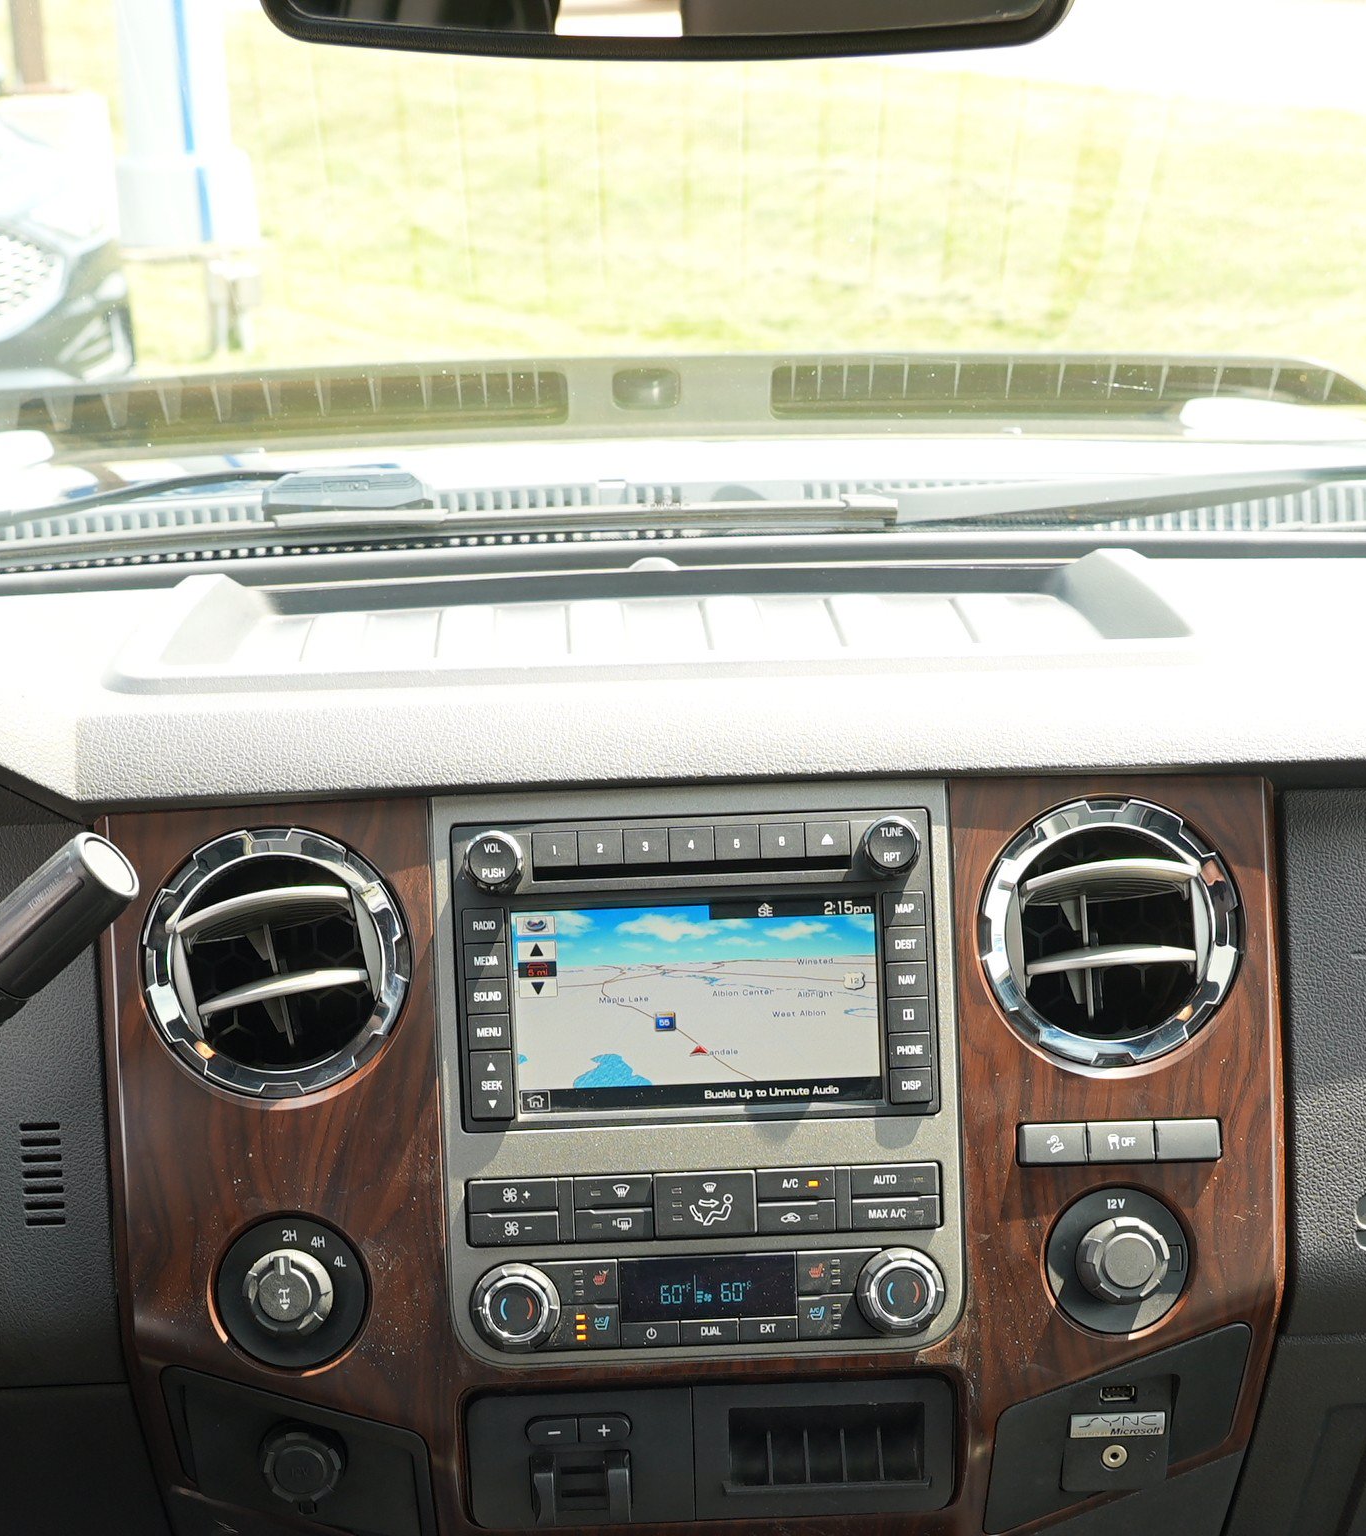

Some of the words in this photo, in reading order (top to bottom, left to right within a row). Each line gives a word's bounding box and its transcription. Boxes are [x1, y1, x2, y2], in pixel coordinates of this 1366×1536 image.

[880, 826, 903, 838] TUNE
[642, 842, 649, 852] 3
[688, 840, 694, 850] 4
[733, 838, 740, 848] 5
[778, 837, 785, 847] 6
[484, 843, 501, 853] VOL
[596, 843, 603, 853] 2
[884, 851, 901, 863] RPT
[481, 867, 505, 879] PUSH
[758, 906, 773, 917] SE
[824, 901, 872, 916] 2:15pm
[895, 904, 914, 914] MAP
[473, 921, 496, 931] RADIO
[895, 939, 916, 950] DEST
[474, 956, 498, 966] MEDIA
[797, 958, 834, 966] Winsted
[898, 975, 916, 985] NAV
[474, 991, 501, 1001] SOUND
[712, 989, 739, 997] Albion
[742, 988, 773, 996] Center
[797, 990, 833, 999] Albright
[599, 996, 624, 1004] Maple
[628, 995, 649, 1003] Lake
[772, 1010, 795, 1018] West
[800, 1009, 826, 1017] Albion
[477, 1027, 501, 1037] MENU
[709, 1048, 739, 1057] andale
[896, 1045, 923, 1055] PHONE
[481, 1080, 502, 1090] SEEK
[901, 1080, 922, 1091] DISP
[704, 1089, 736, 1099] Buckle
[739, 1089, 754, 1099] Up
[756, 1089, 767, 1097] to
[769, 1086, 809, 1096] Unmute
[812, 1085, 839, 1095] Audio
[1121, 1136, 1136, 1147] OFF
[782, 1178, 799, 1189] A/C
[873, 1174, 897, 1185] AUTO
[1107, 1199, 1126, 1210] 12V
[868, 1209, 888, 1220] MAX
[890, 1208, 907, 1219] A/C
[282, 1229, 297, 1241] 2H
[311, 1236, 326, 1248] 4H
[334, 1256, 347, 1268] 4L
[700, 1326, 721, 1337] DUAL
[760, 1323, 776, 1334] EXT
[1078, 1414, 1157, 1429] SYNC
[1110, 1427, 1160, 1436] Microsoft
